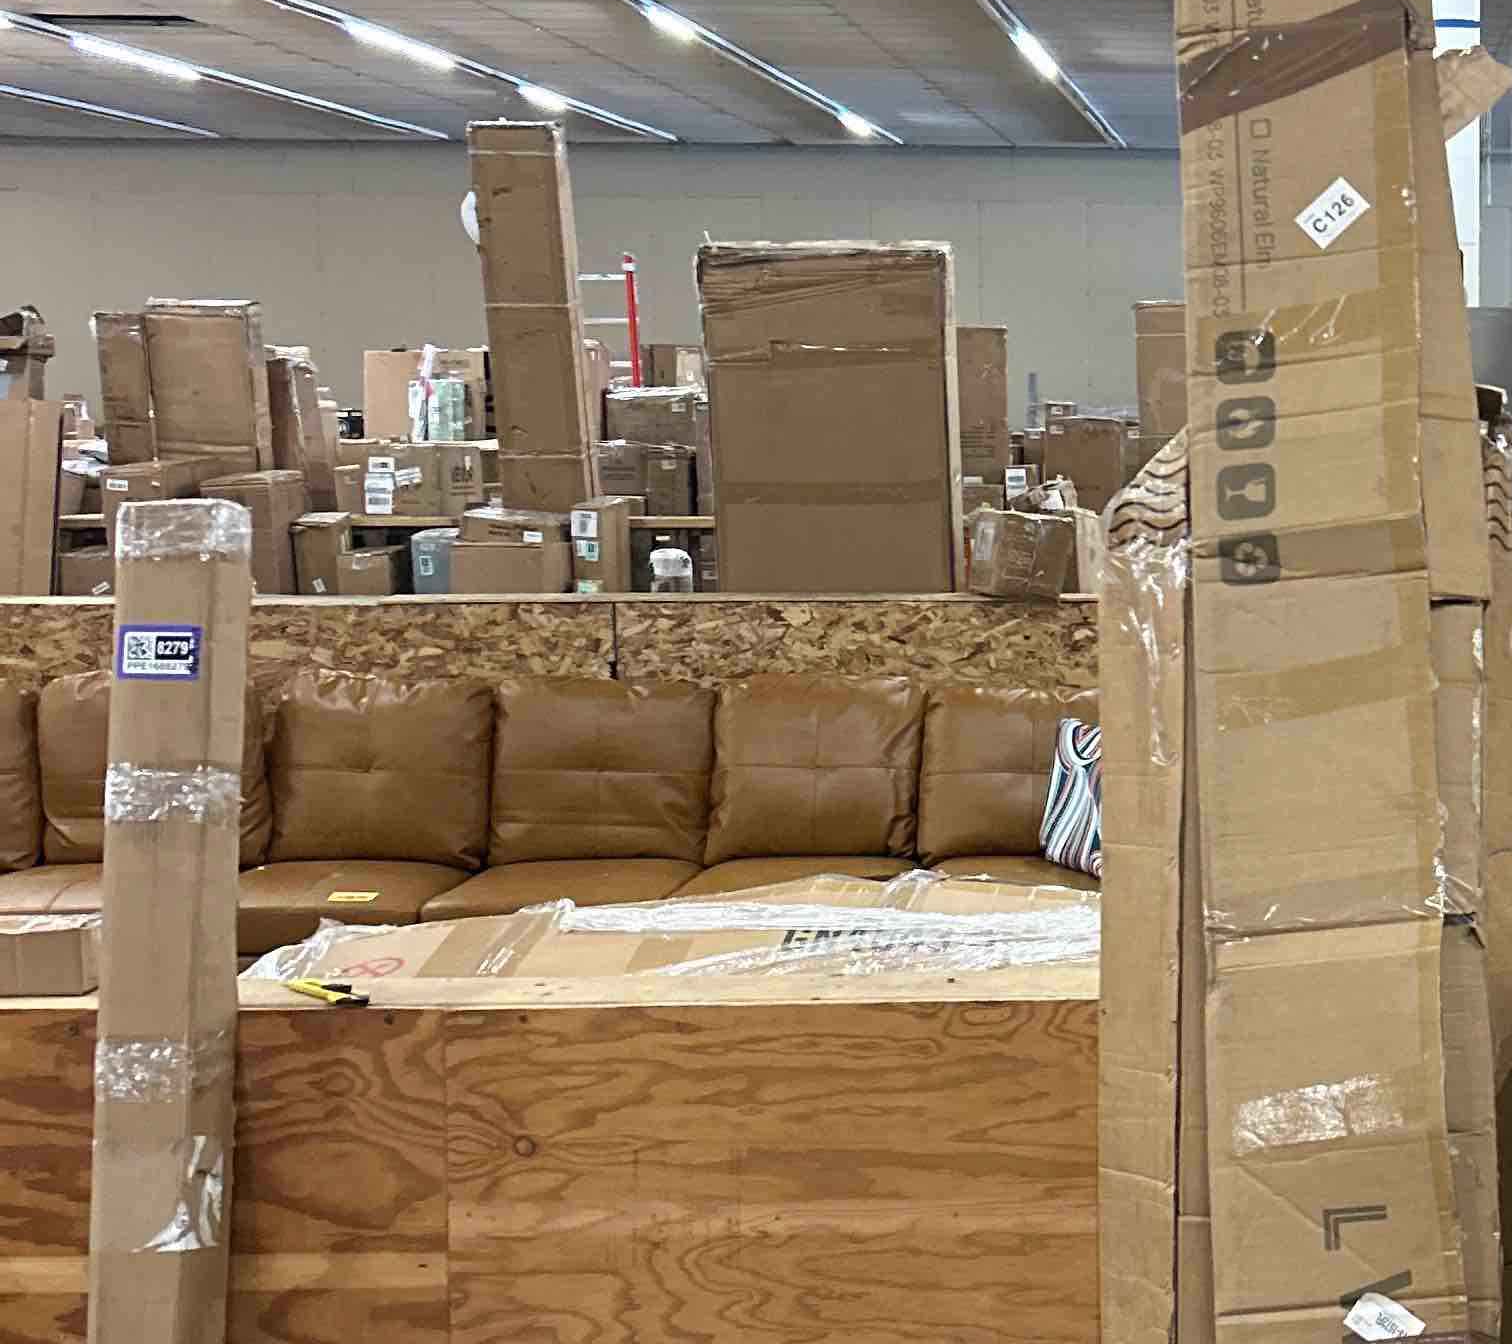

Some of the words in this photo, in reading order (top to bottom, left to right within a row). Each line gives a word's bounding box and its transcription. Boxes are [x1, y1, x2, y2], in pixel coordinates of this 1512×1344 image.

[1252, 149, 1272, 227] Natural
[1312, 191, 1356, 236] C126
[1256, 232, 1274, 269] Elm
[157, 641, 189, 655] 8279
